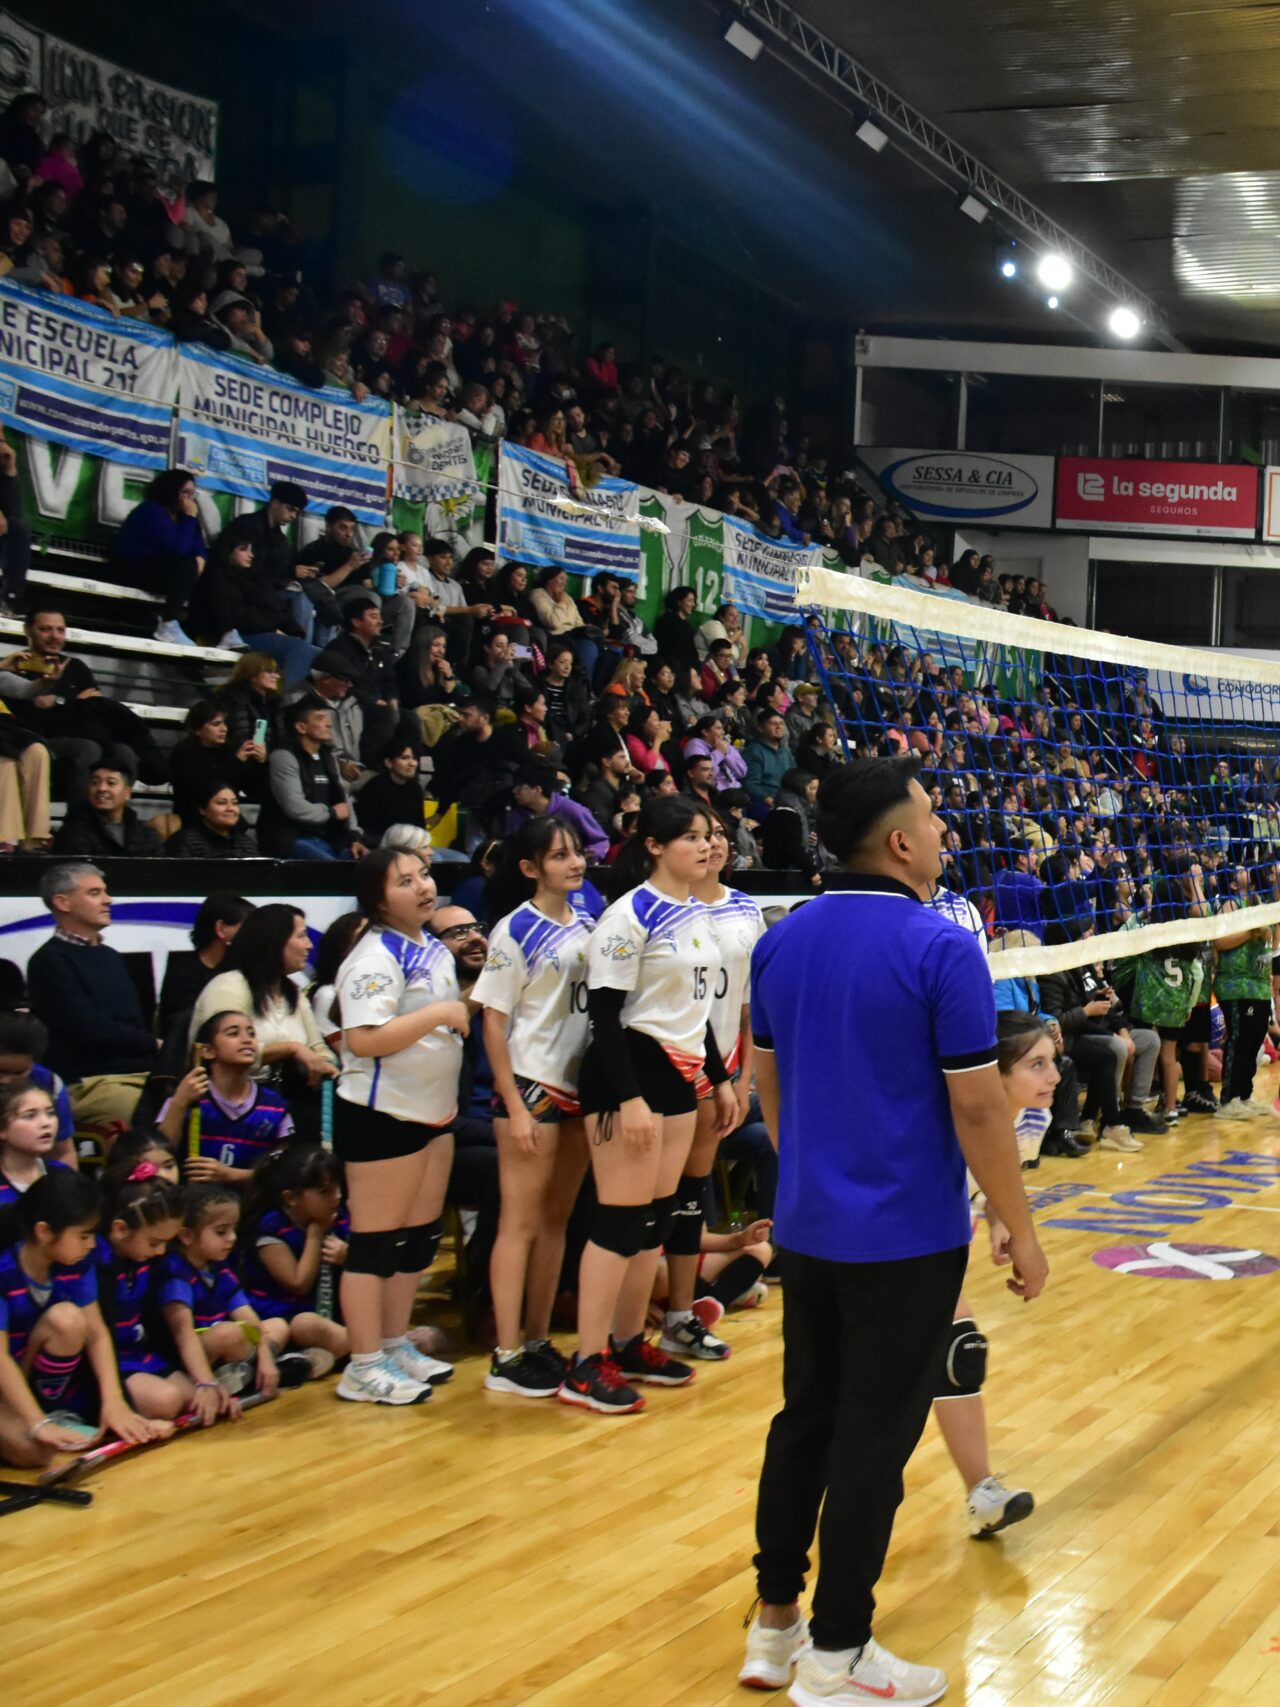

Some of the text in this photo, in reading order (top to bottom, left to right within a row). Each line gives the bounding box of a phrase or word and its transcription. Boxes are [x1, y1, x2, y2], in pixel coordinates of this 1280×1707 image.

[26, 309, 140, 370] ESCUELA
[214, 374, 362, 436] SEDE COMPLEJO
[193, 396, 302, 446] MUNICIPAL
[305, 427, 381, 465] HUERGO
[912, 466, 1014, 486] SESSA & CIA
[1112, 475, 1135, 497] la
[1138, 481, 1238, 503] segunda
[1150, 506, 1198, 515] SEGUROS
[695, 566, 719, 615] 12
[693, 966, 709, 1000] 15
[1164, 957, 1184, 988] 5
[570, 980, 590, 1014] 10
[220, 1143, 236, 1168] 6
